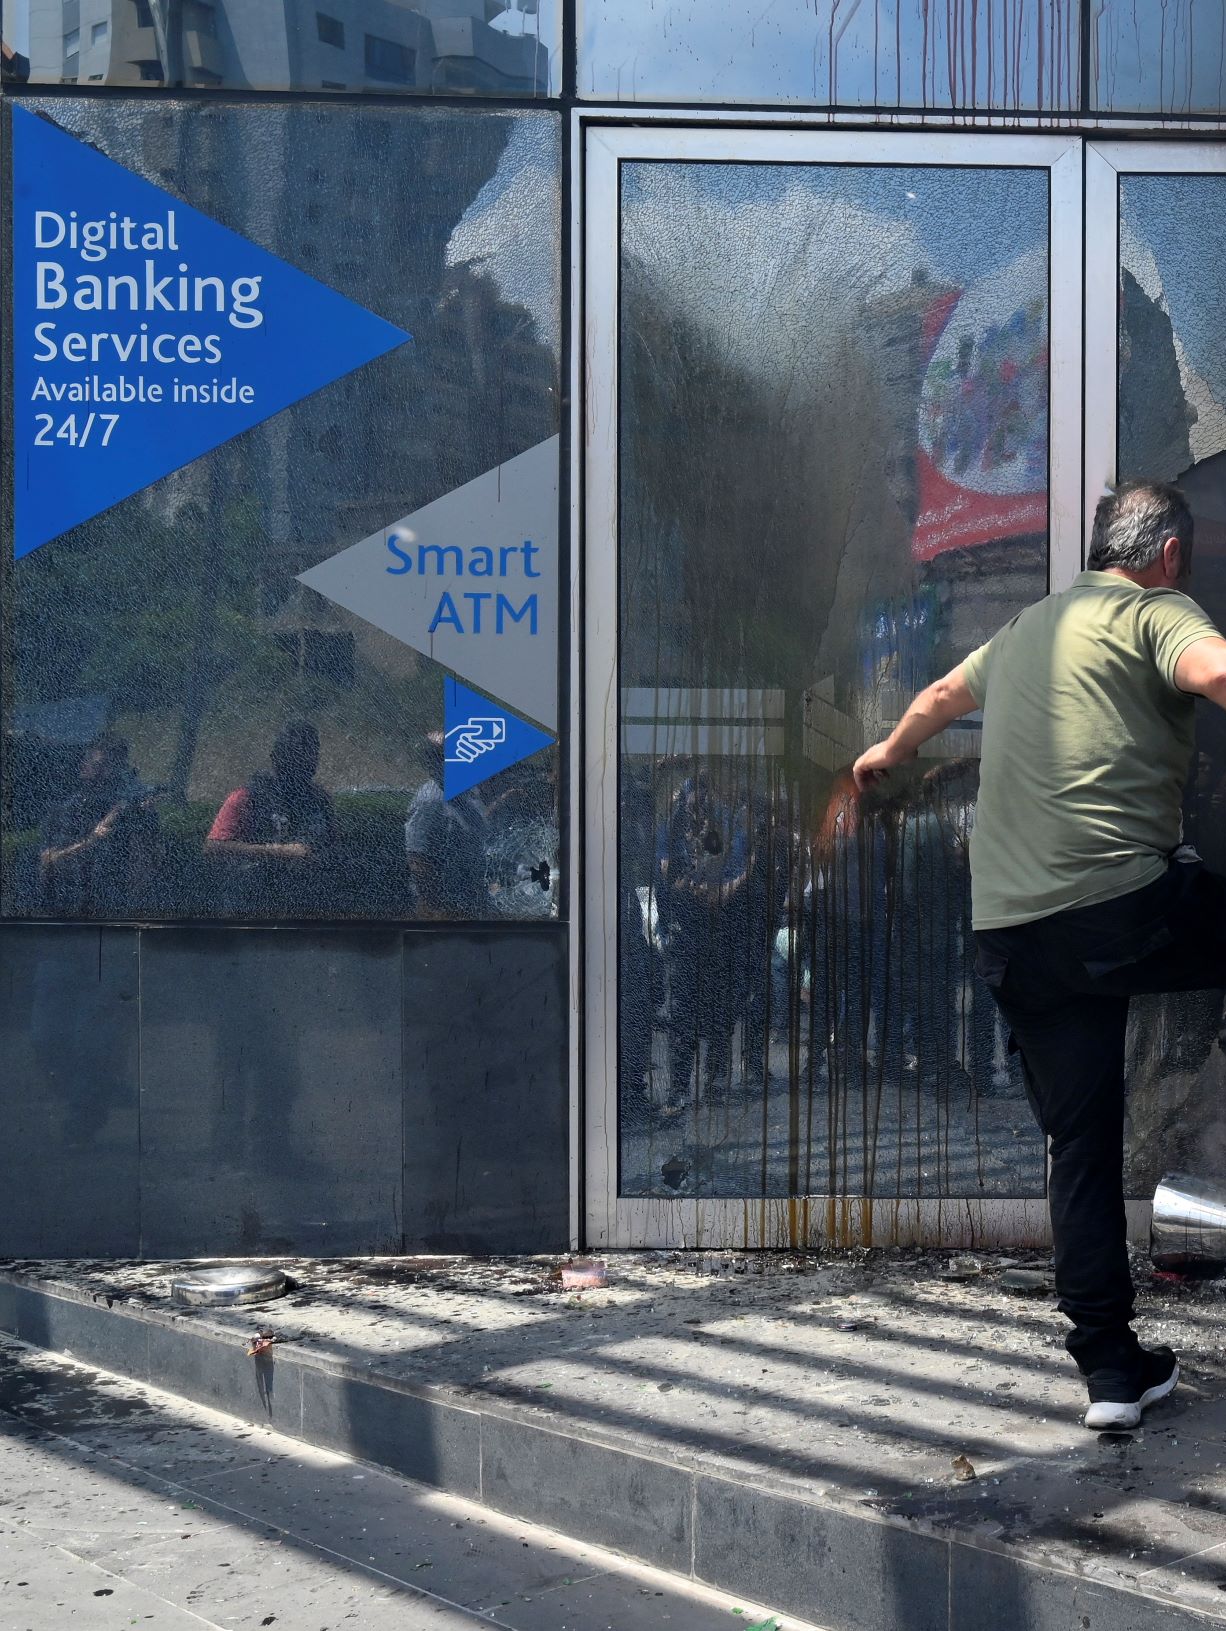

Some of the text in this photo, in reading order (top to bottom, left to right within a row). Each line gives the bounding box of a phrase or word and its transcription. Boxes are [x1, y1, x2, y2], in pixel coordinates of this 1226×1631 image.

[34, 210, 179, 262] Digital
[35, 259, 264, 330] Banking
[33, 322, 222, 364] Services
[31, 375, 255, 404] Available inside
[34, 412, 120, 448] 24/7
[385, 533, 542, 579] Smart
[428, 591, 539, 636] ATM
